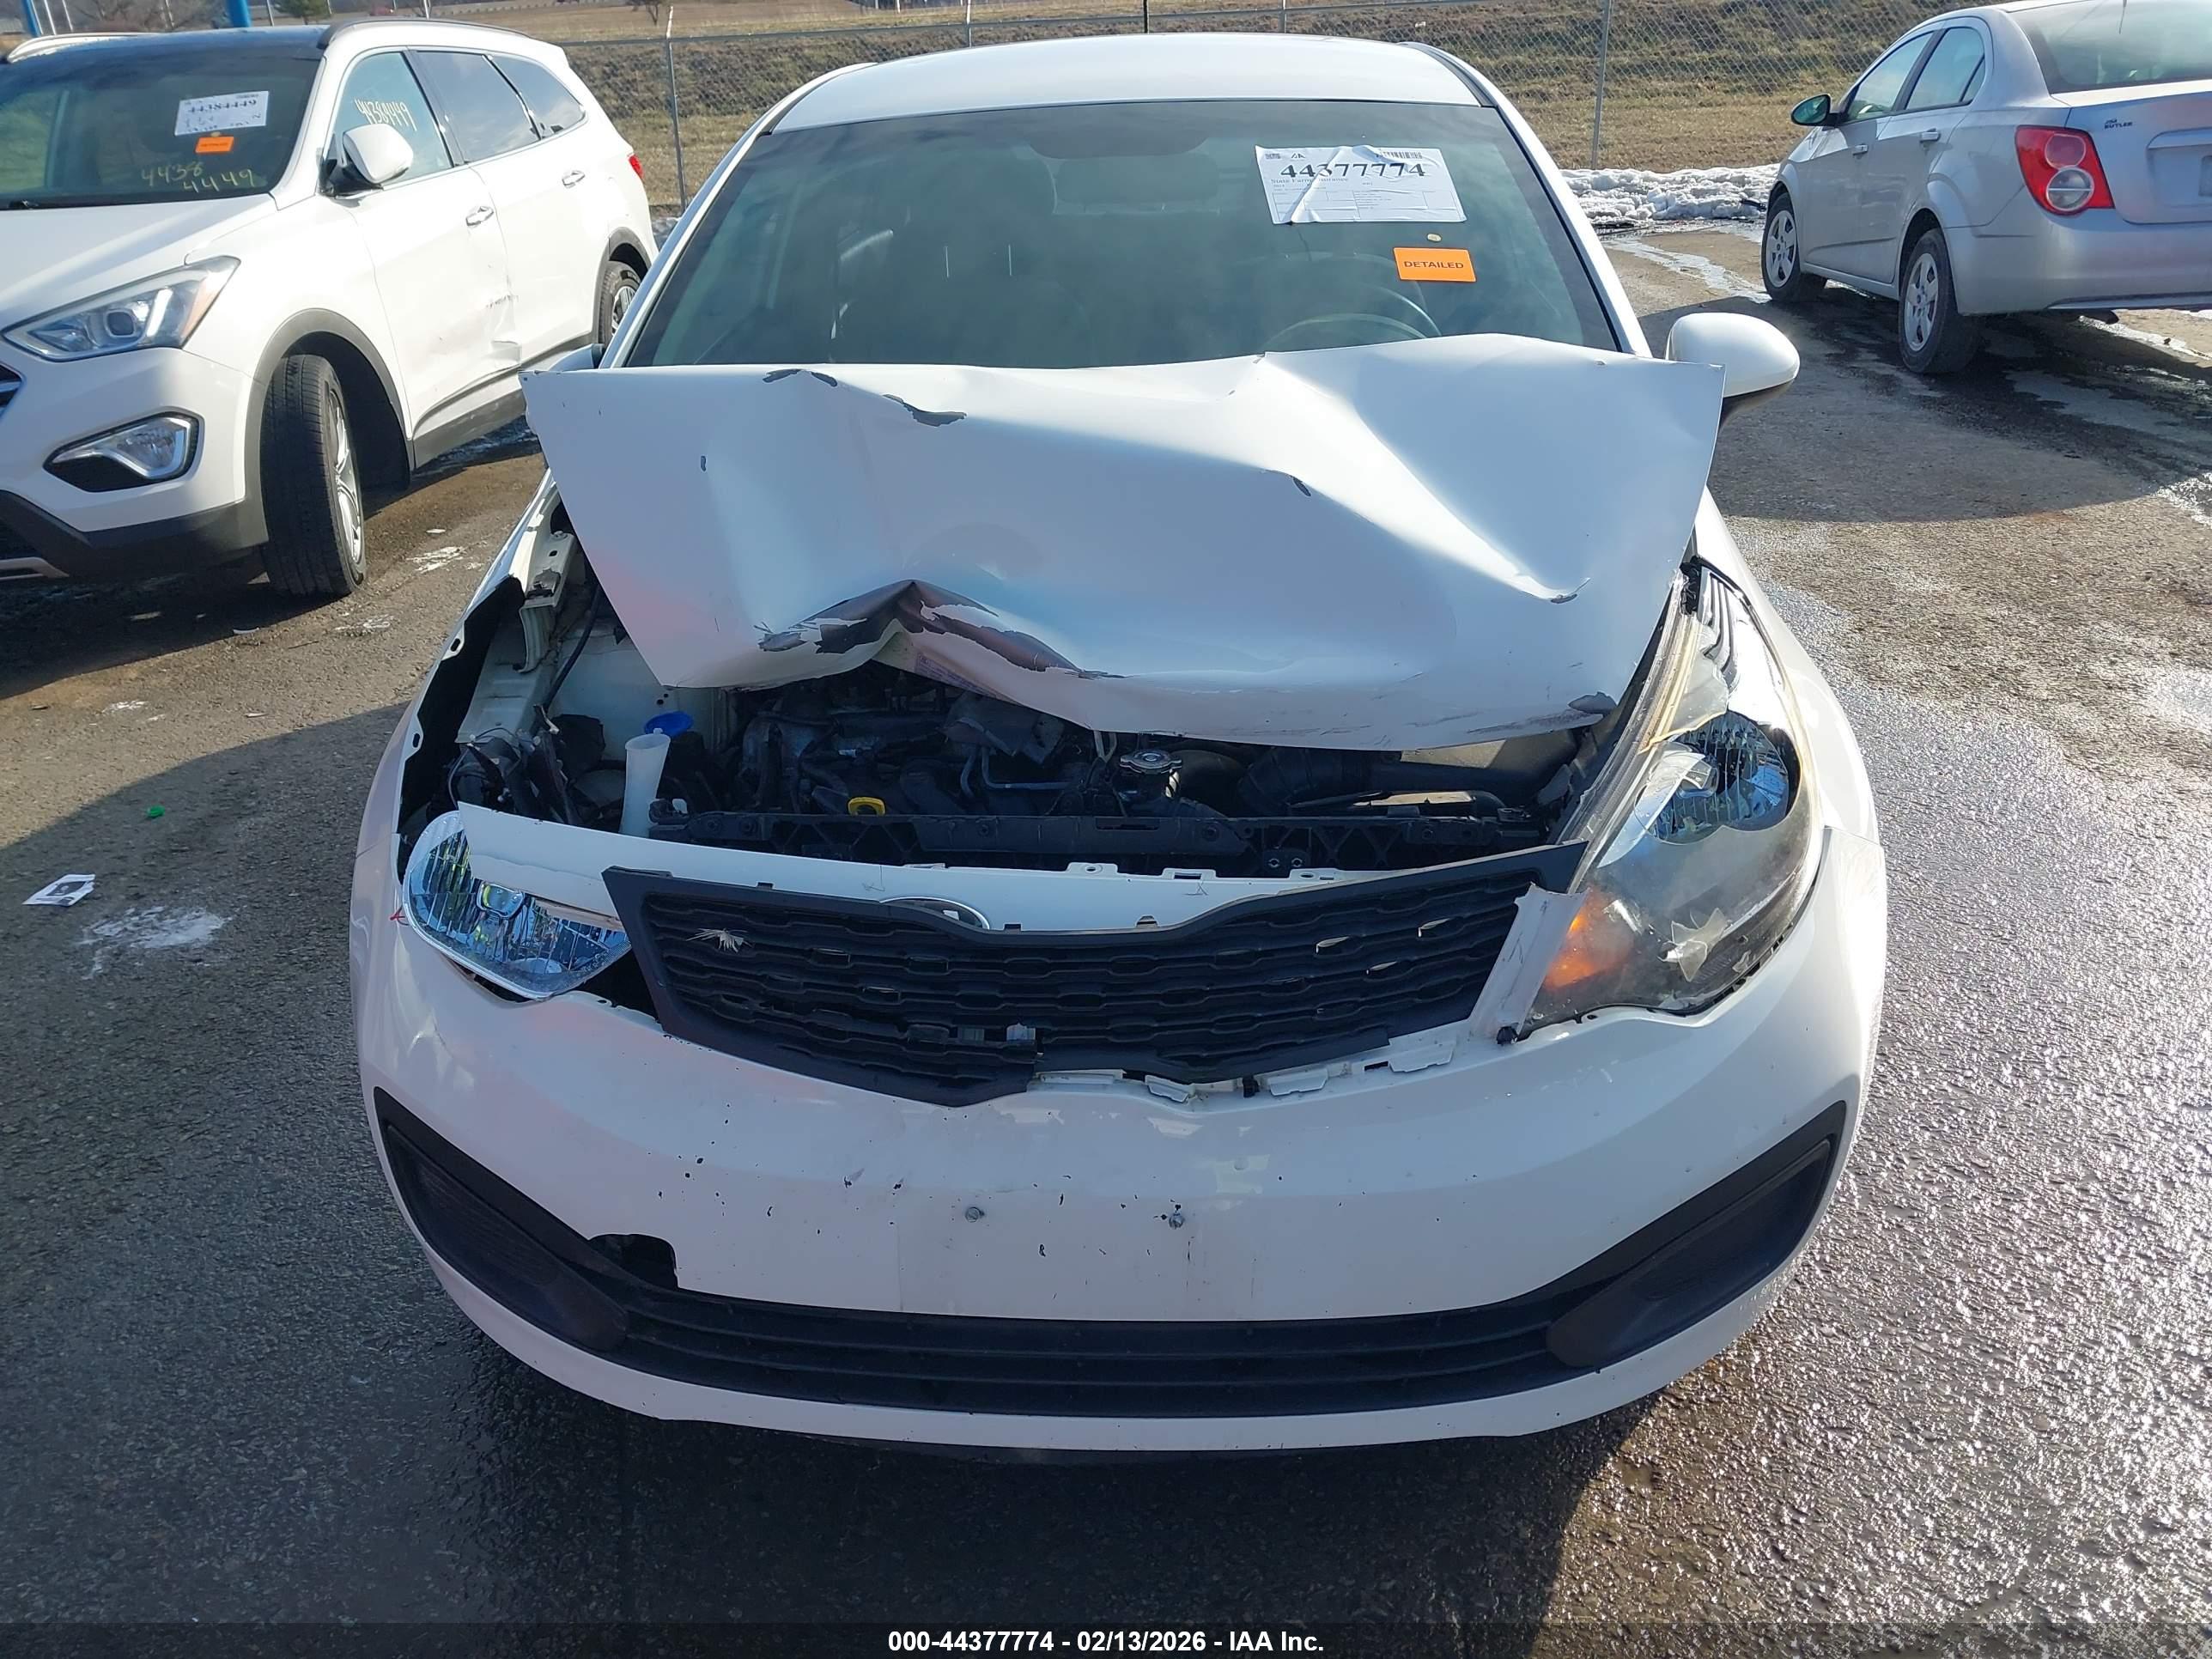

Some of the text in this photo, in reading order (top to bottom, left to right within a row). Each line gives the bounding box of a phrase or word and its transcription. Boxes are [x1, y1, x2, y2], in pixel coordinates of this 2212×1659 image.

[1280, 163, 1426, 178] 44377774
[183, 168, 255, 193] 4449
[1403, 260, 1464, 269] DETAILED
